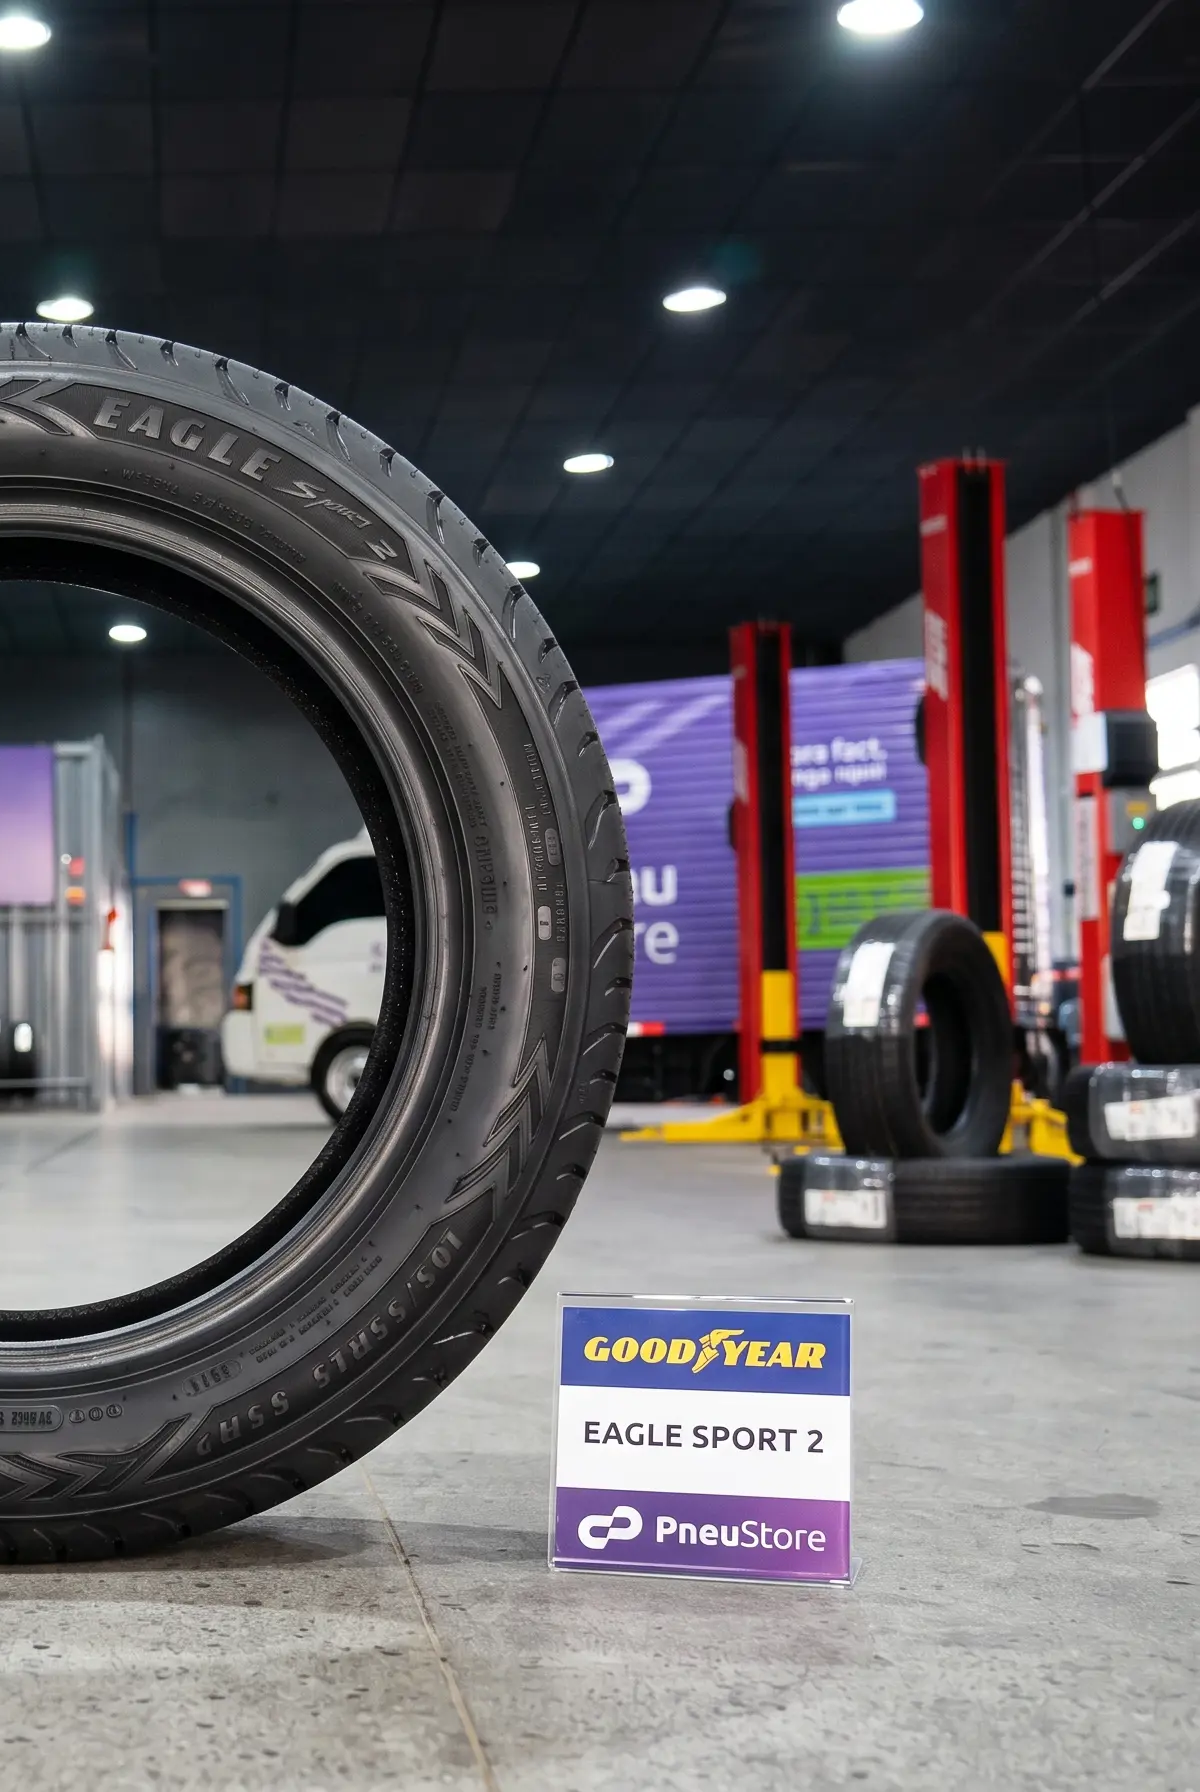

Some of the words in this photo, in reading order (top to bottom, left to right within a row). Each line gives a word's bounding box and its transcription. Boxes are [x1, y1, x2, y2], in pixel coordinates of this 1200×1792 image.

[93, 397, 281, 481] EAGLE
[584, 1421, 682, 1447] EAGLE
[692, 1425, 797, 1452] SPORT
[807, 1429, 824, 1453] 2
[656, 1515, 826, 1552] PneuStore
